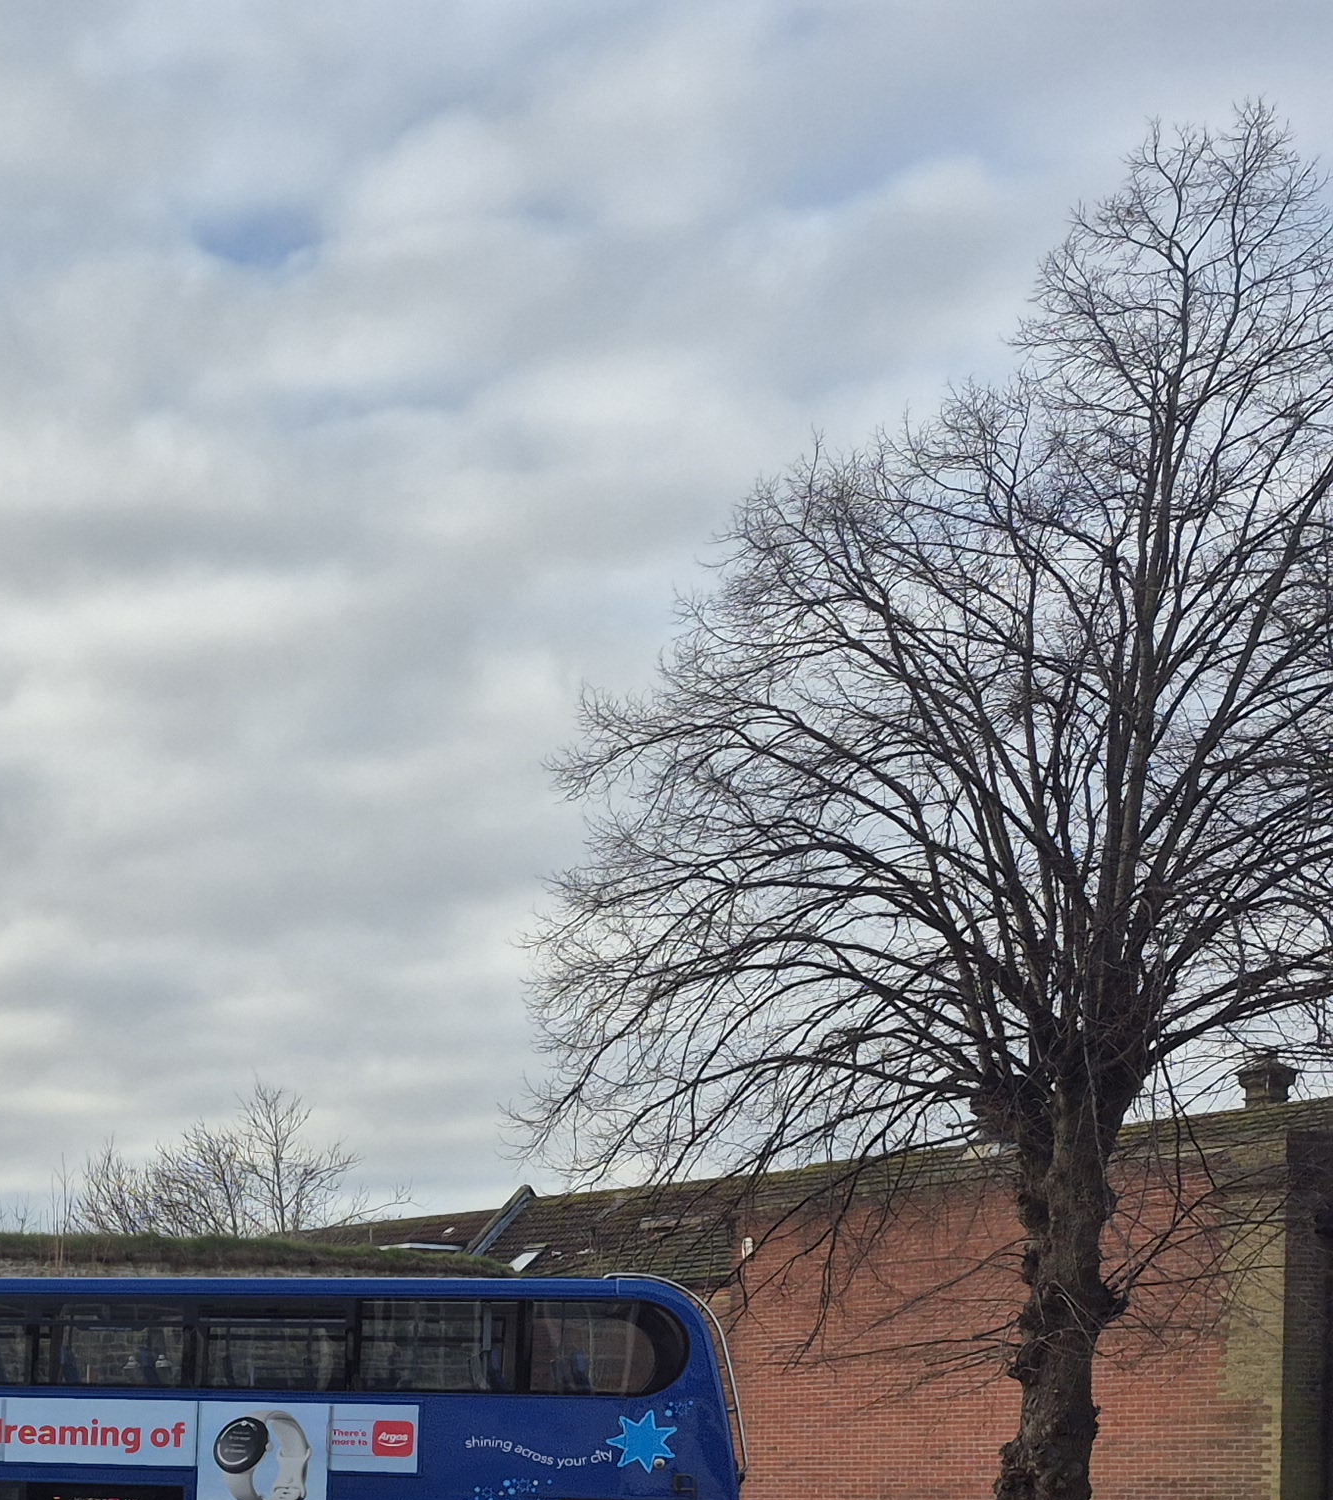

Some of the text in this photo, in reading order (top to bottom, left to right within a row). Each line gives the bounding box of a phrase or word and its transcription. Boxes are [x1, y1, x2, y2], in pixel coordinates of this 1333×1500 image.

[150, 1422, 186, 1448] of
[332, 1438, 355, 1446] more
[378, 1431, 408, 1444] Argos
[464, 1436, 613, 1469] shining across your city
